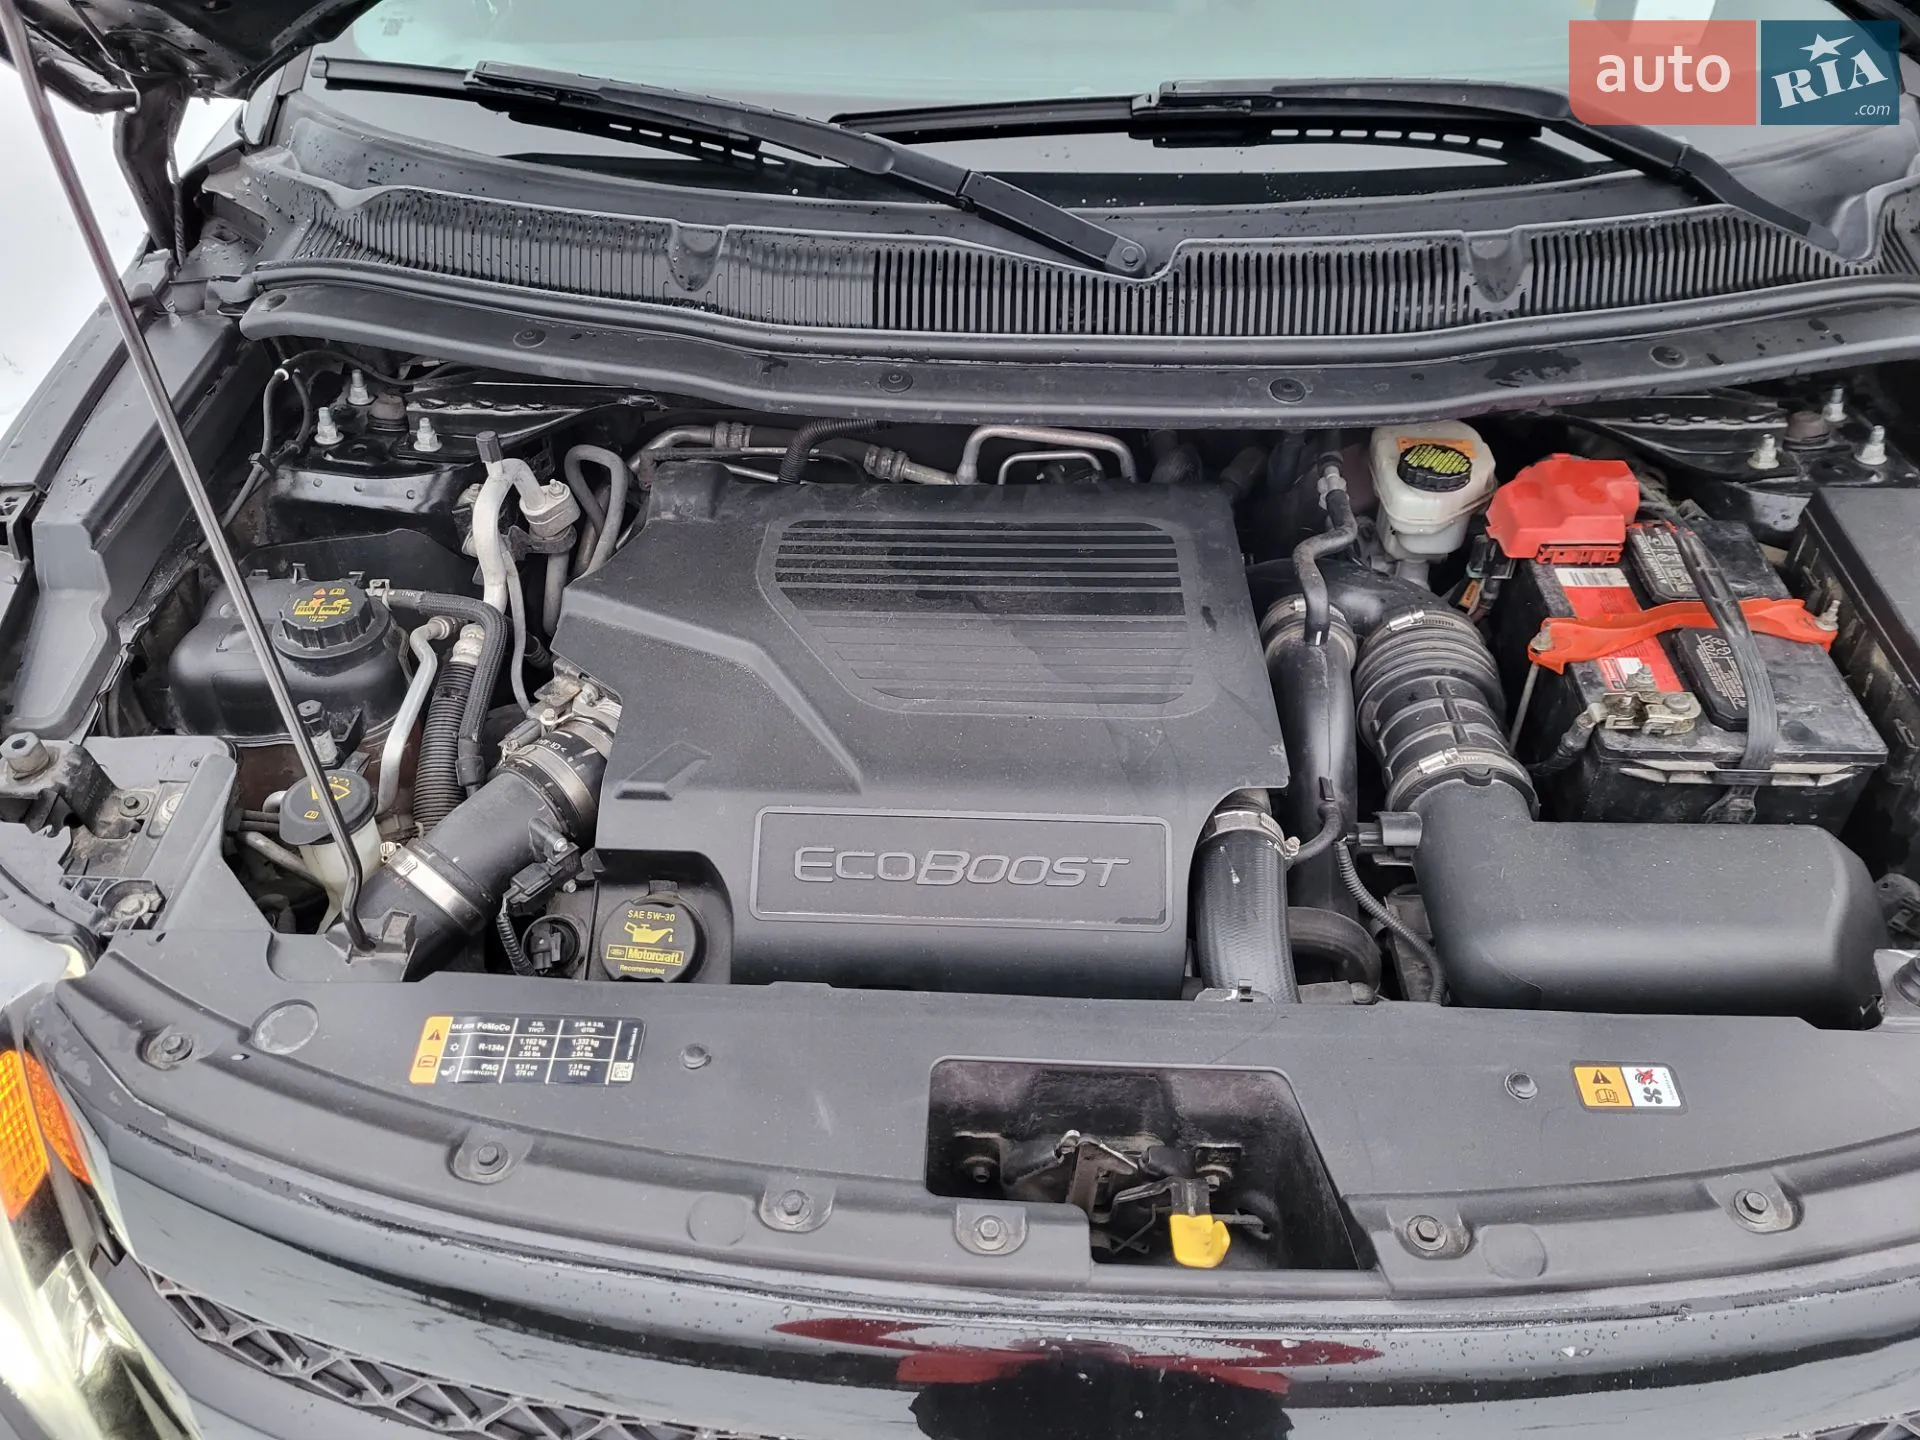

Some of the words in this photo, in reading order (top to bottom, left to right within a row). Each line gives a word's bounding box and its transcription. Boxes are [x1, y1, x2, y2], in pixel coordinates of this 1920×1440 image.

[628, 909, 645, 919] SAE
[647, 911, 676, 922] 5W-30
[628, 948, 681, 963] Motorcraft
[619, 964, 665, 975] Recommended
[477, 1022, 511, 1032] FoMoCo
[478, 1043, 505, 1052] R-134a
